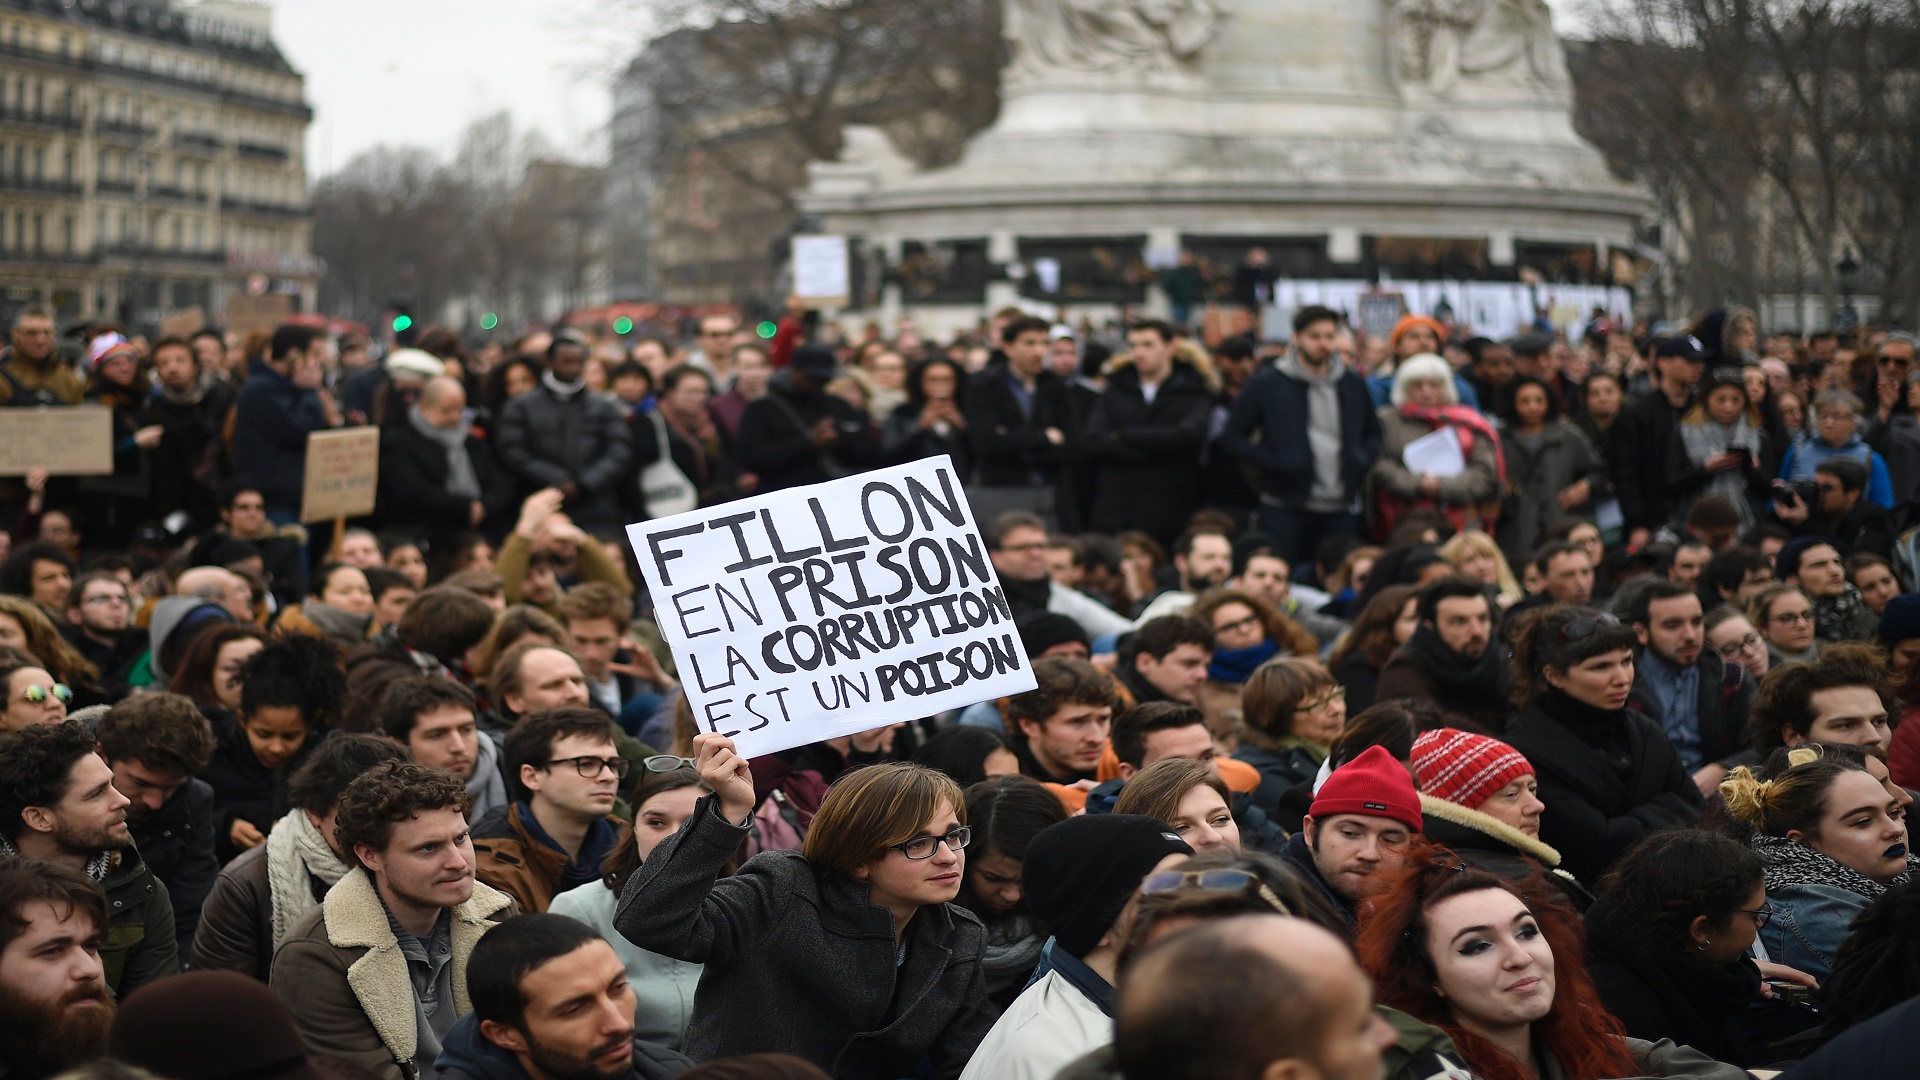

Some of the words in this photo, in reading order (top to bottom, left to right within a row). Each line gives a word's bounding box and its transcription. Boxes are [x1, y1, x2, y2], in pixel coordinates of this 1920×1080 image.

[647, 469, 967, 587] FILLON
[672, 577, 764, 638] EN
[768, 534, 991, 622] PRISON
[690, 646, 760, 693] LA
[761, 586, 1011, 674] CORRUPTION
[705, 687, 790, 737] EST
[812, 672, 871, 711] UN
[875, 634, 1020, 702] POISON
